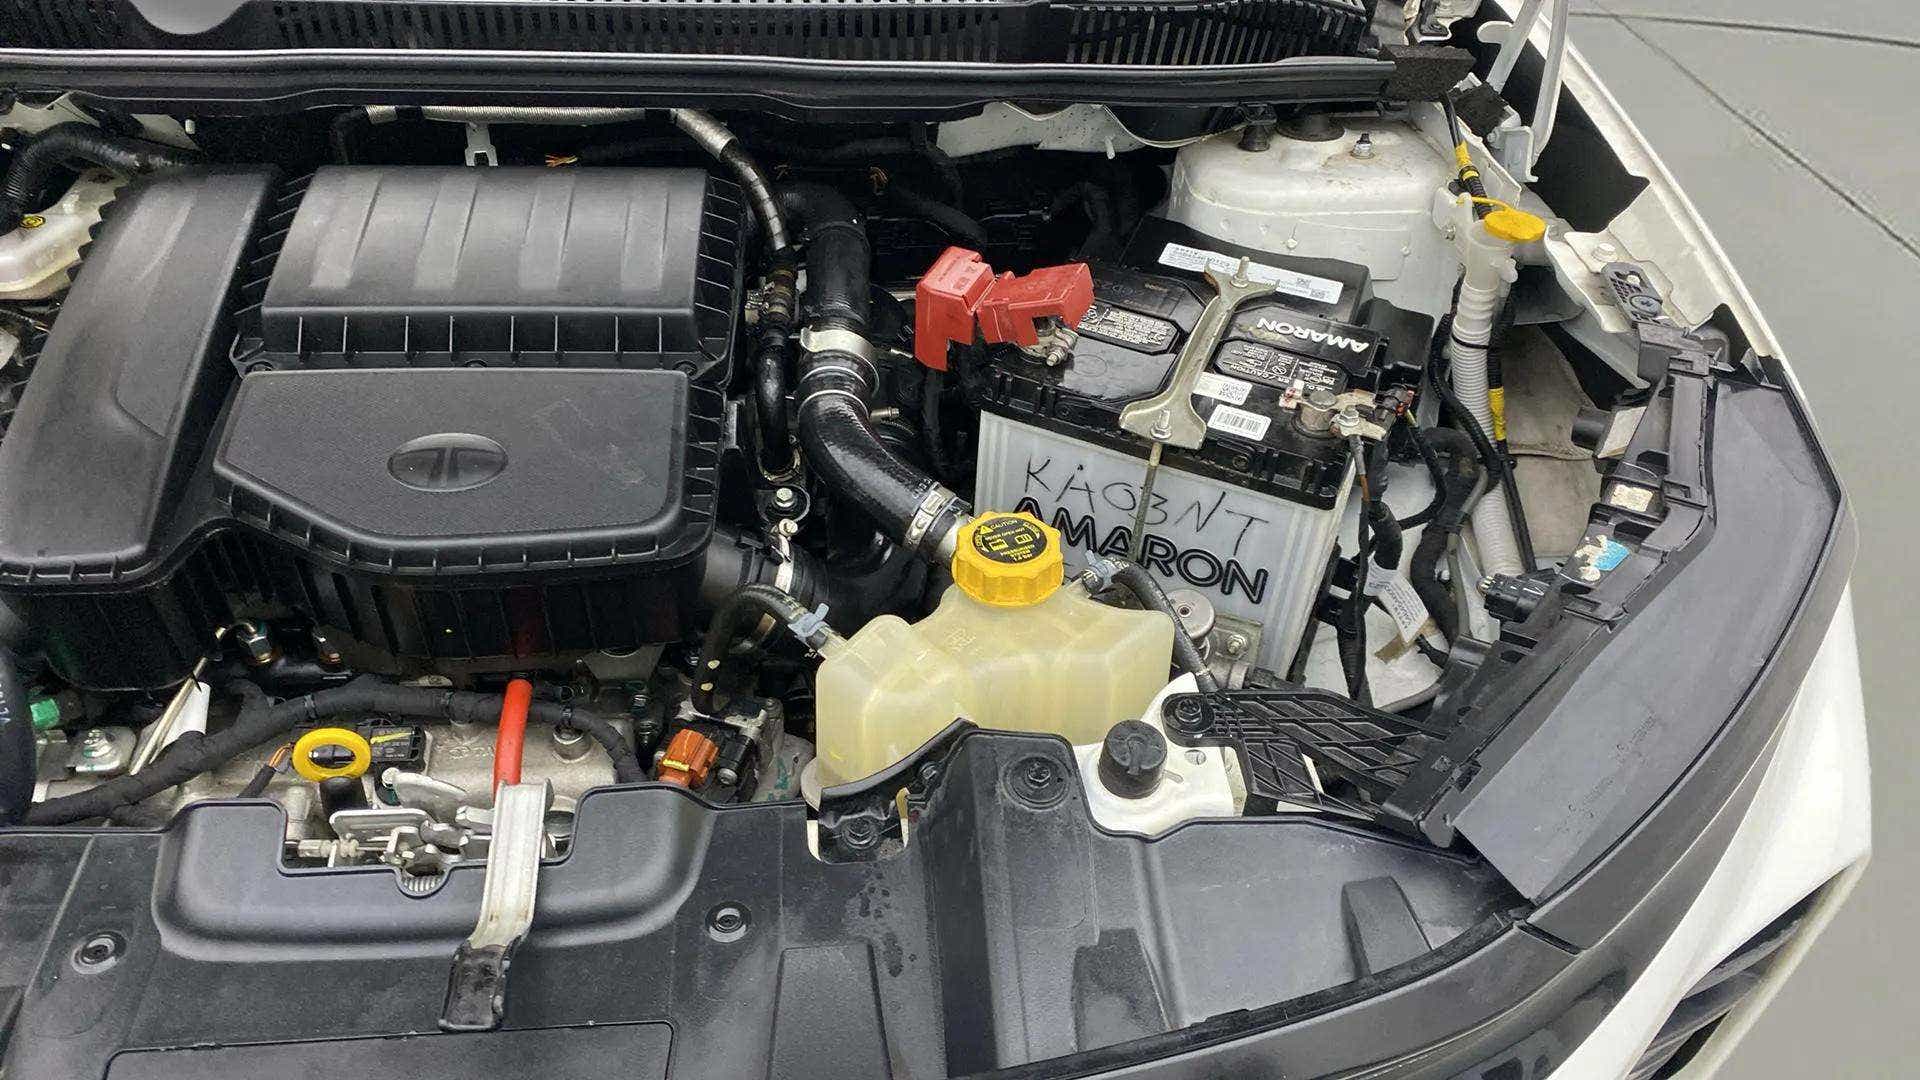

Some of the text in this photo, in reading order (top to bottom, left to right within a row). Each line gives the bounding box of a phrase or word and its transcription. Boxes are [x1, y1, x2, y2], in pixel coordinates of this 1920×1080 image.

[1256, 317, 1370, 354] AMARON
[1230, 364, 1269, 379] CAUTION
[990, 519, 1018, 530] CAUTION
[1012, 496, 1269, 605] AMARON
